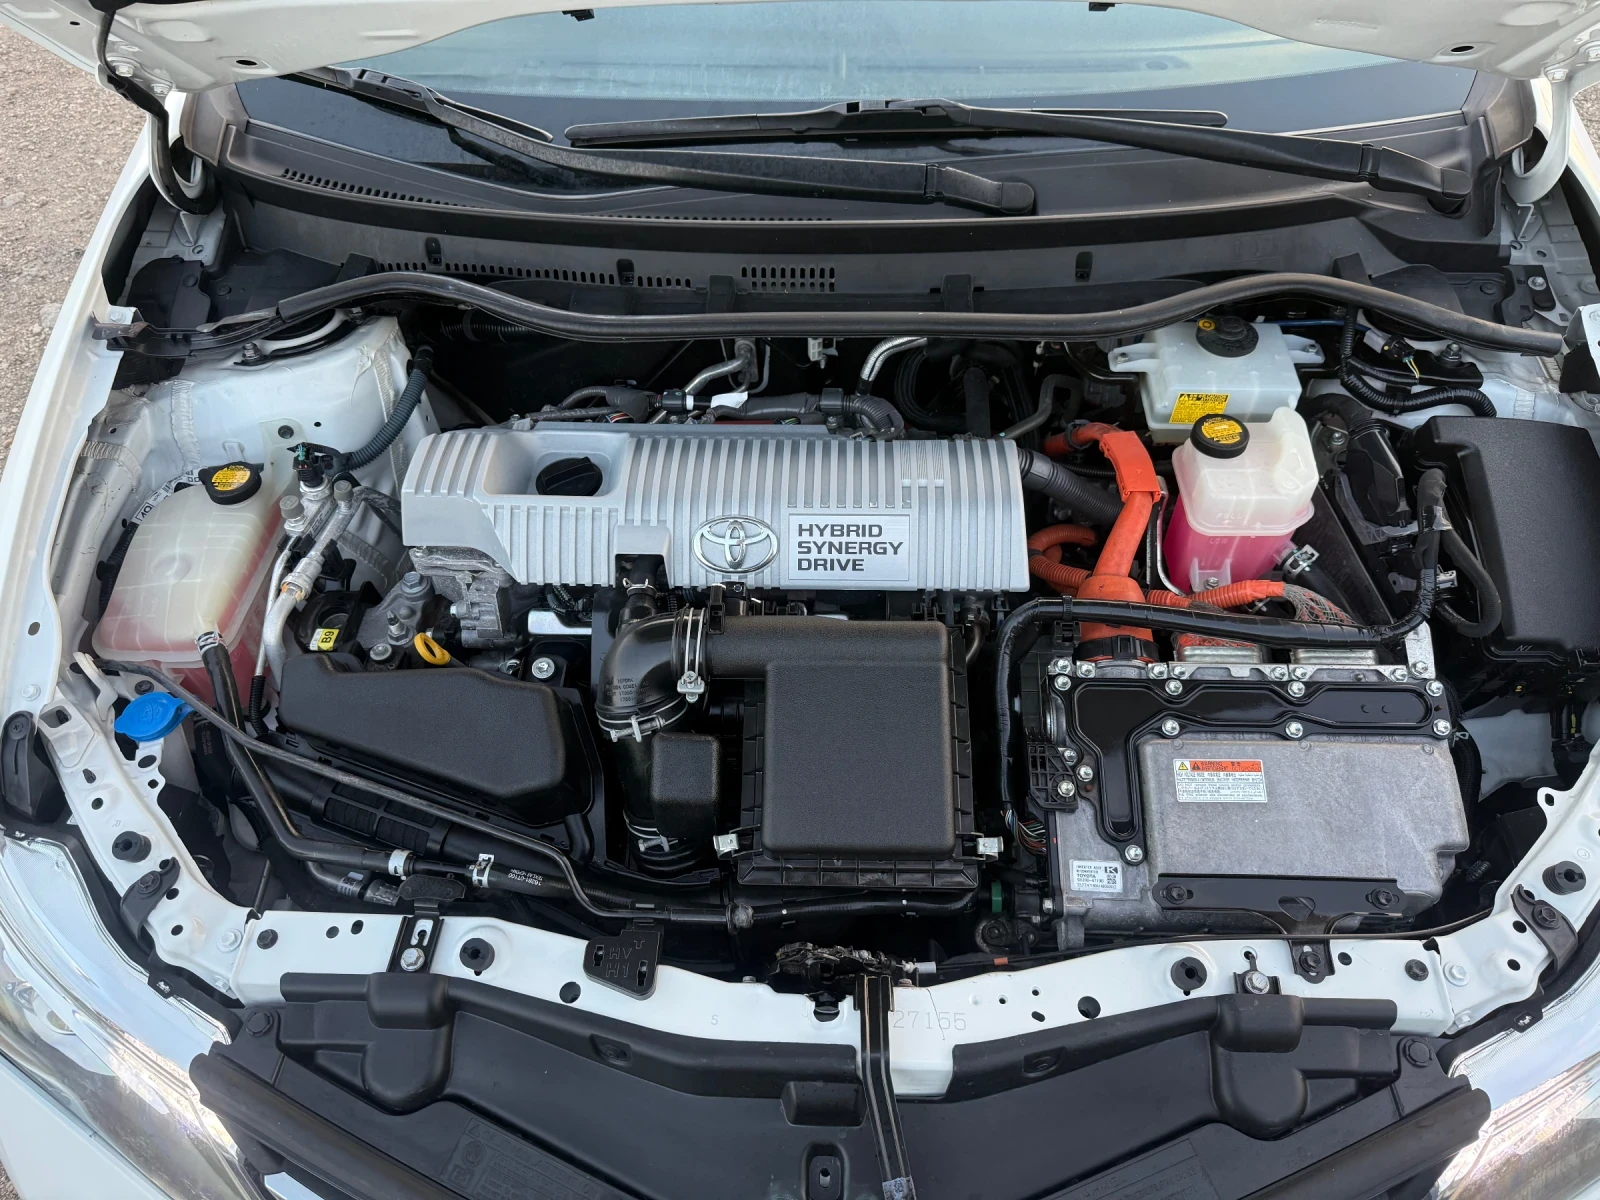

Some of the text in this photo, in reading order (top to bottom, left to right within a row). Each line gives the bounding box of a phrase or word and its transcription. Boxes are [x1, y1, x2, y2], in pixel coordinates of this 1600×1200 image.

[1216, 512, 1243, 520] FULL
[797, 523, 883, 538] HYBRID
[797, 541, 904, 555] SYNERGY
[797, 558, 865, 572] DRIVE
[320, 630, 335, 644] B9
[608, 947, 633, 960] HV
[605, 962, 630, 978] H1
[710, 1013, 719, 1026] 5
[892, 1010, 967, 1031] 27155
